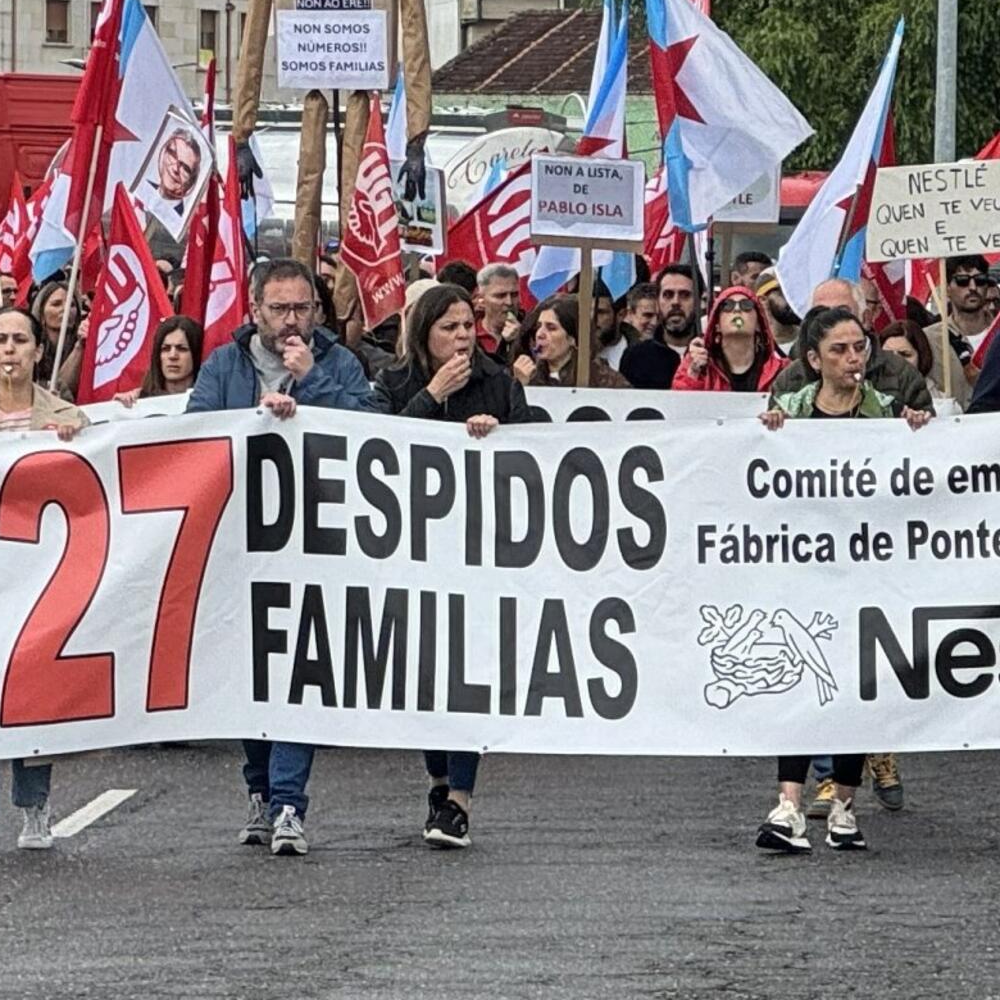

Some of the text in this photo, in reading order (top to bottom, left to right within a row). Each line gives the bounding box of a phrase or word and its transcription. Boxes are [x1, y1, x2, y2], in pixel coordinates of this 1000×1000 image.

[293, 23, 371, 35] NON SOMOS
[281, 61, 386, 72] SOMOS FAMILIAS
[545, 165, 623, 181] NON A LISTA,
[908, 163, 988, 195] NESTLÉ
[573, 184, 589, 195] DE
[538, 200, 623, 218] PABLO ISLA
[876, 202, 925, 225] QUEN
[940, 200, 962, 215] TE
[935, 220, 947, 235] E
[880, 236, 929, 258] QUEN
[942, 235, 967, 252] TE
[746, 456, 877, 500] Comité
[890, 457, 935, 497] de
[246, 433, 668, 572] DESPIDOS
[698, 521, 835, 565] Fábrica
[850, 522, 893, 562] de
[250, 581, 640, 721] FAMILIAS
[859, 603, 1000, 701] Ne
